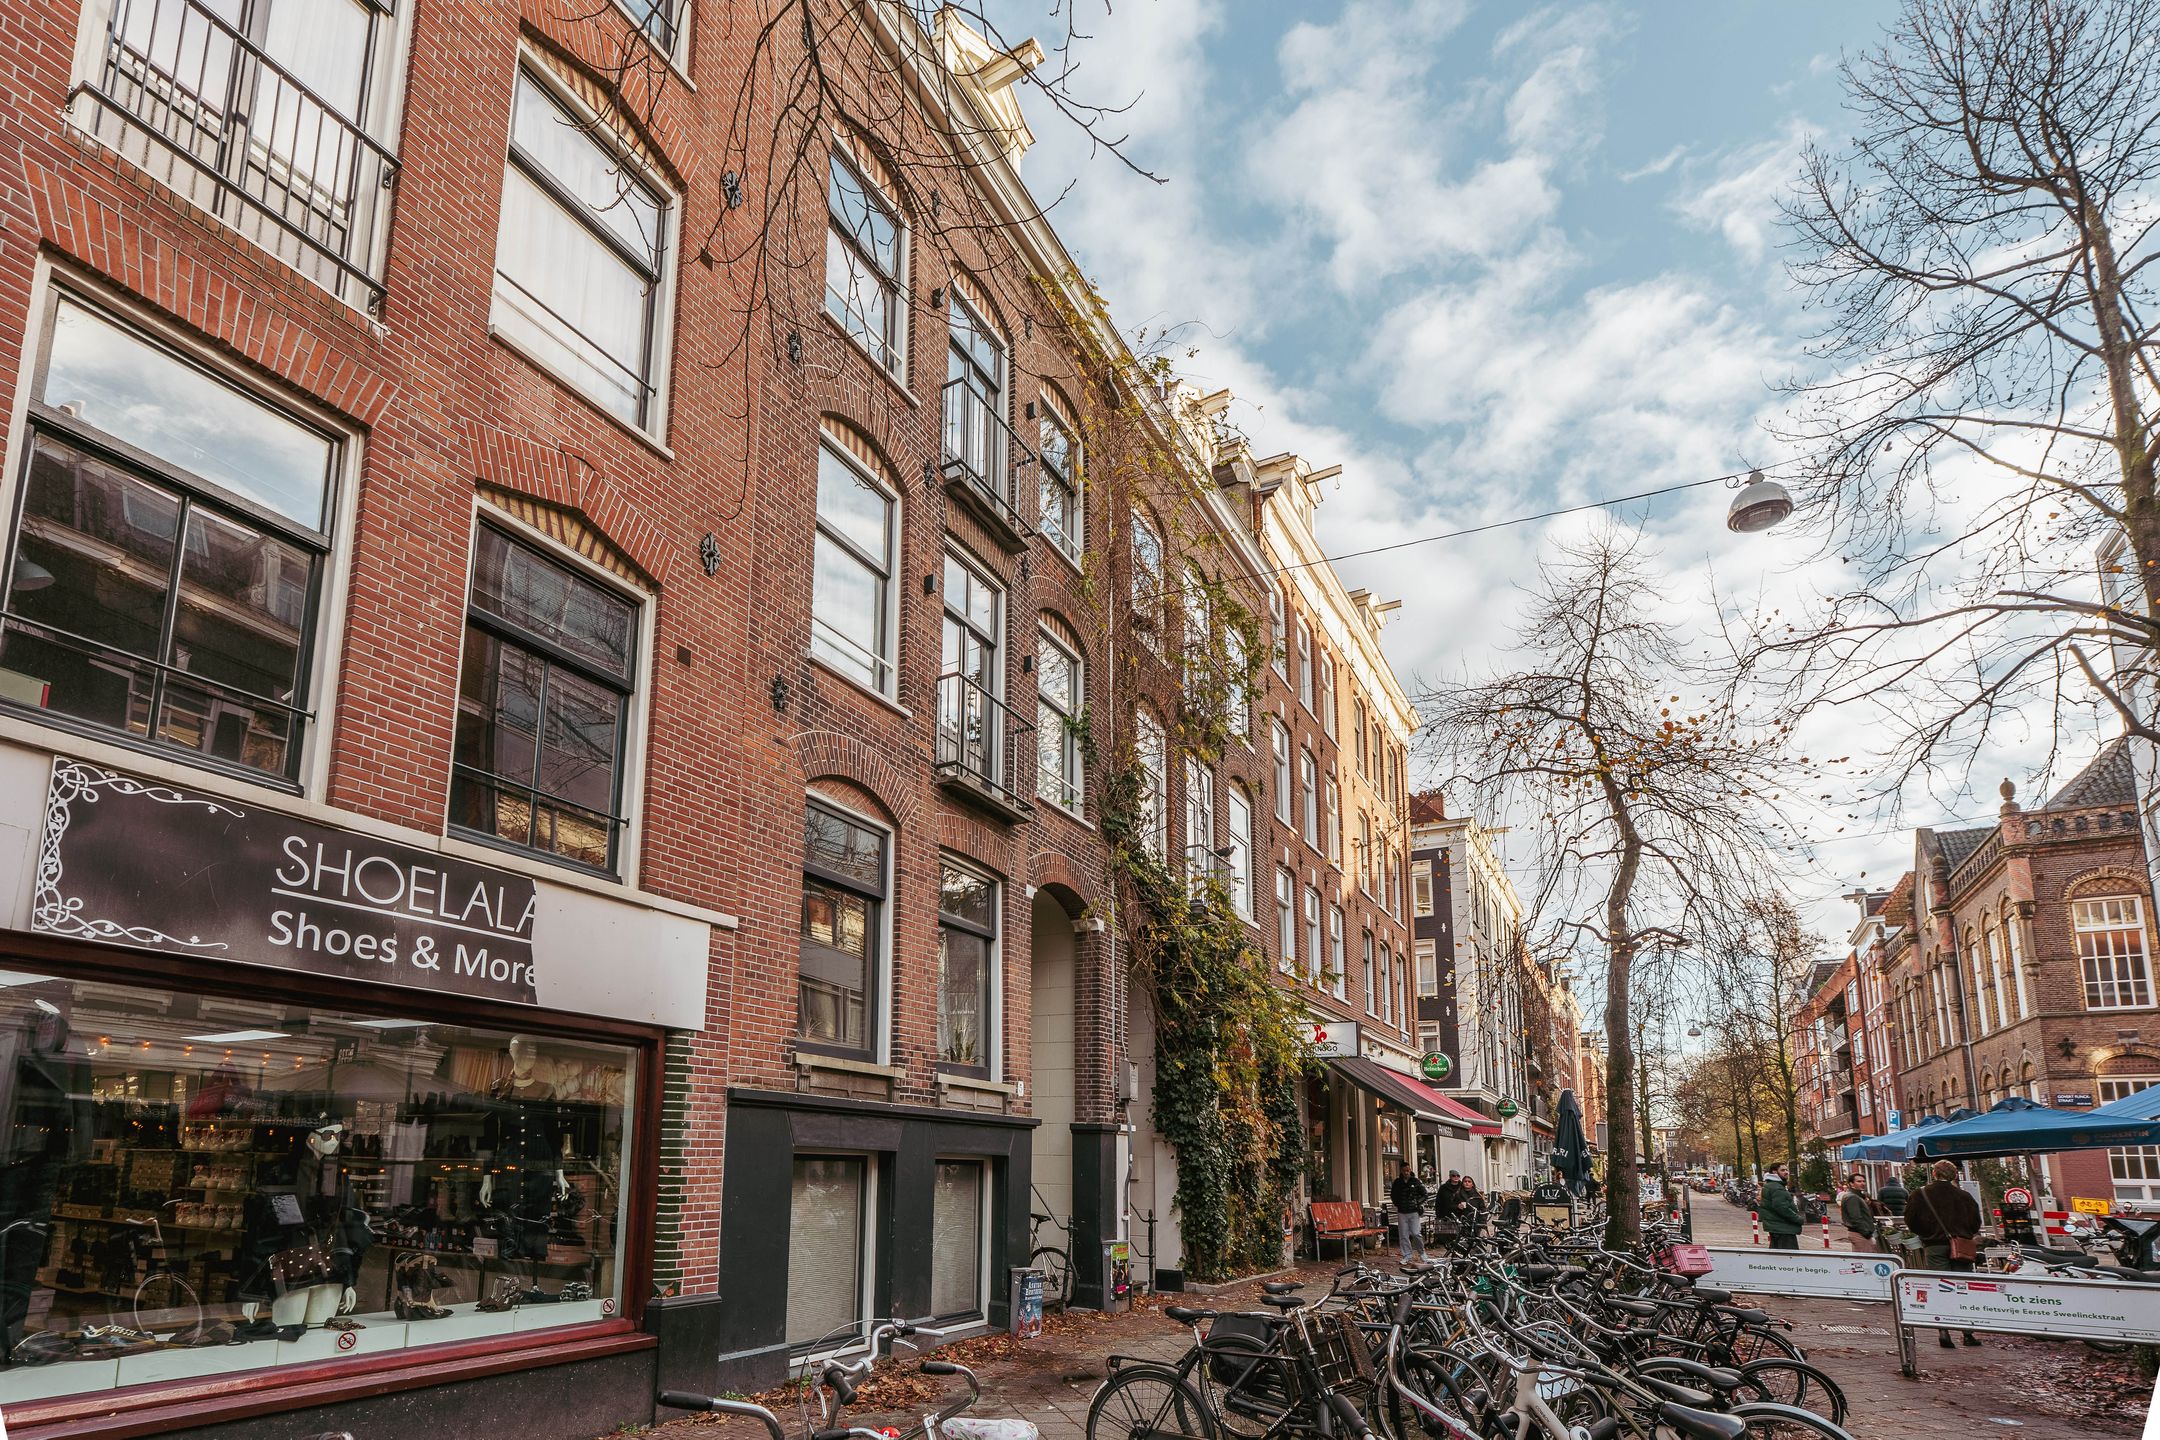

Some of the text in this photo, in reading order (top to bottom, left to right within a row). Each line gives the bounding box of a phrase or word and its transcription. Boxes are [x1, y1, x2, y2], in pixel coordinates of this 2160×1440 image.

[275, 835, 536, 933] SHOELALA
[267, 910, 398, 963] Shoes
[411, 935, 441, 971] &
[1889, 1112, 1897, 1122] P
[1541, 1189, 1561, 1198] LUZ
[1795, 1266, 1803, 1274] je
[1804, 1266, 1831, 1274] begrip.
[2004, 1293, 2062, 1306] Tot ziens
[1982, 1305, 2020, 1315] fietsvrije
[2053, 1310, 2126, 1322] Sweelinckstraat
